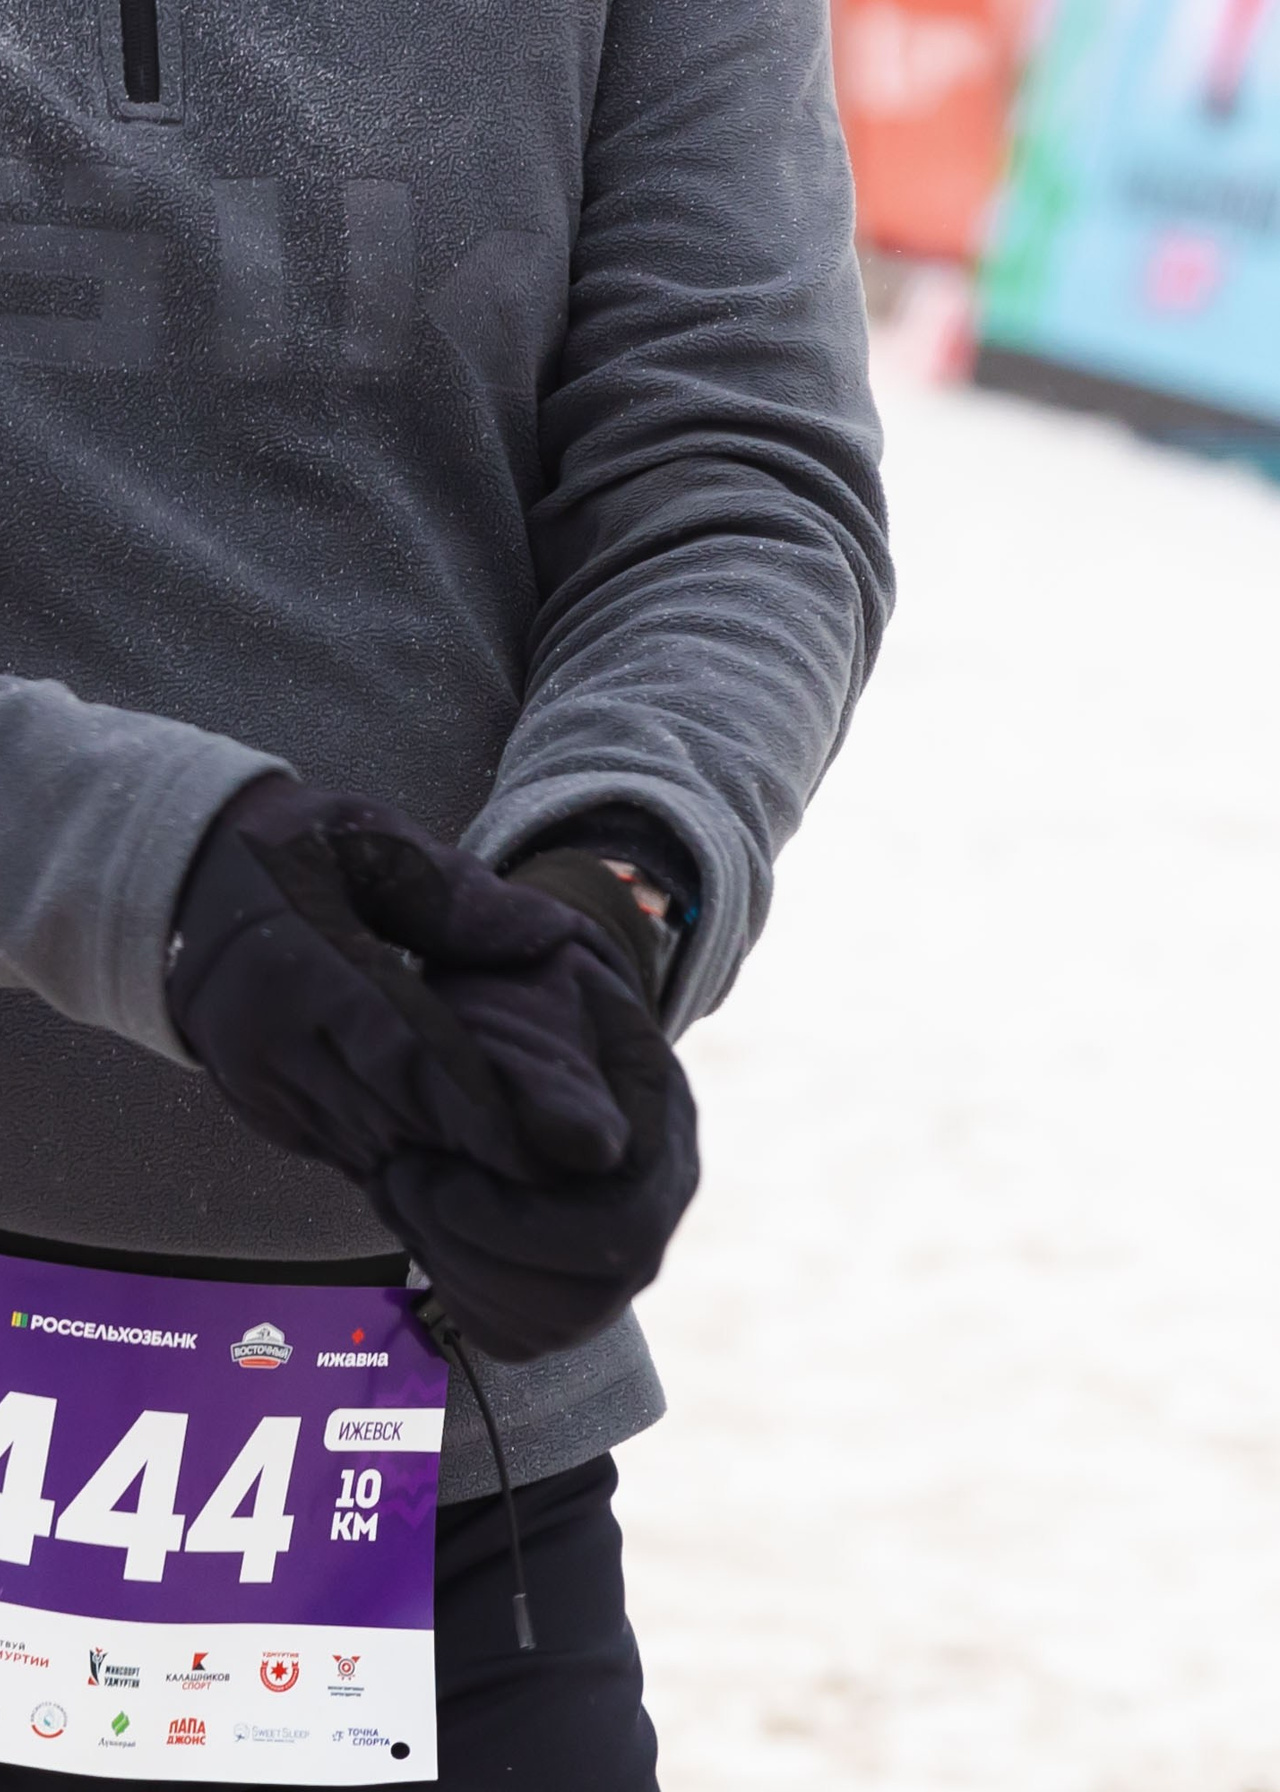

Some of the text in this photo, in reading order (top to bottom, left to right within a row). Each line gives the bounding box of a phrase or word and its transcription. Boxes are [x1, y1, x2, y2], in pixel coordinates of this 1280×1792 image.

[30, 1314, 198, 1350] РОССЕЛЬХОЗБАНК
[338, 1421, 403, 1441] ИЖЕВСК
[335, 1468, 382, 1509] 10
[330, 1511, 379, 1542] КМ
[165, 1673, 230, 1682] КАЛАШНИКОВ
[182, 1681, 211, 1690] СПОРТ
[169, 1717, 206, 1734] ПАПА
[347, 1728, 379, 1737] ТОЧКА
[166, 1735, 206, 1745] ДЖОНС
[352, 1737, 391, 1746] СПОРТА
